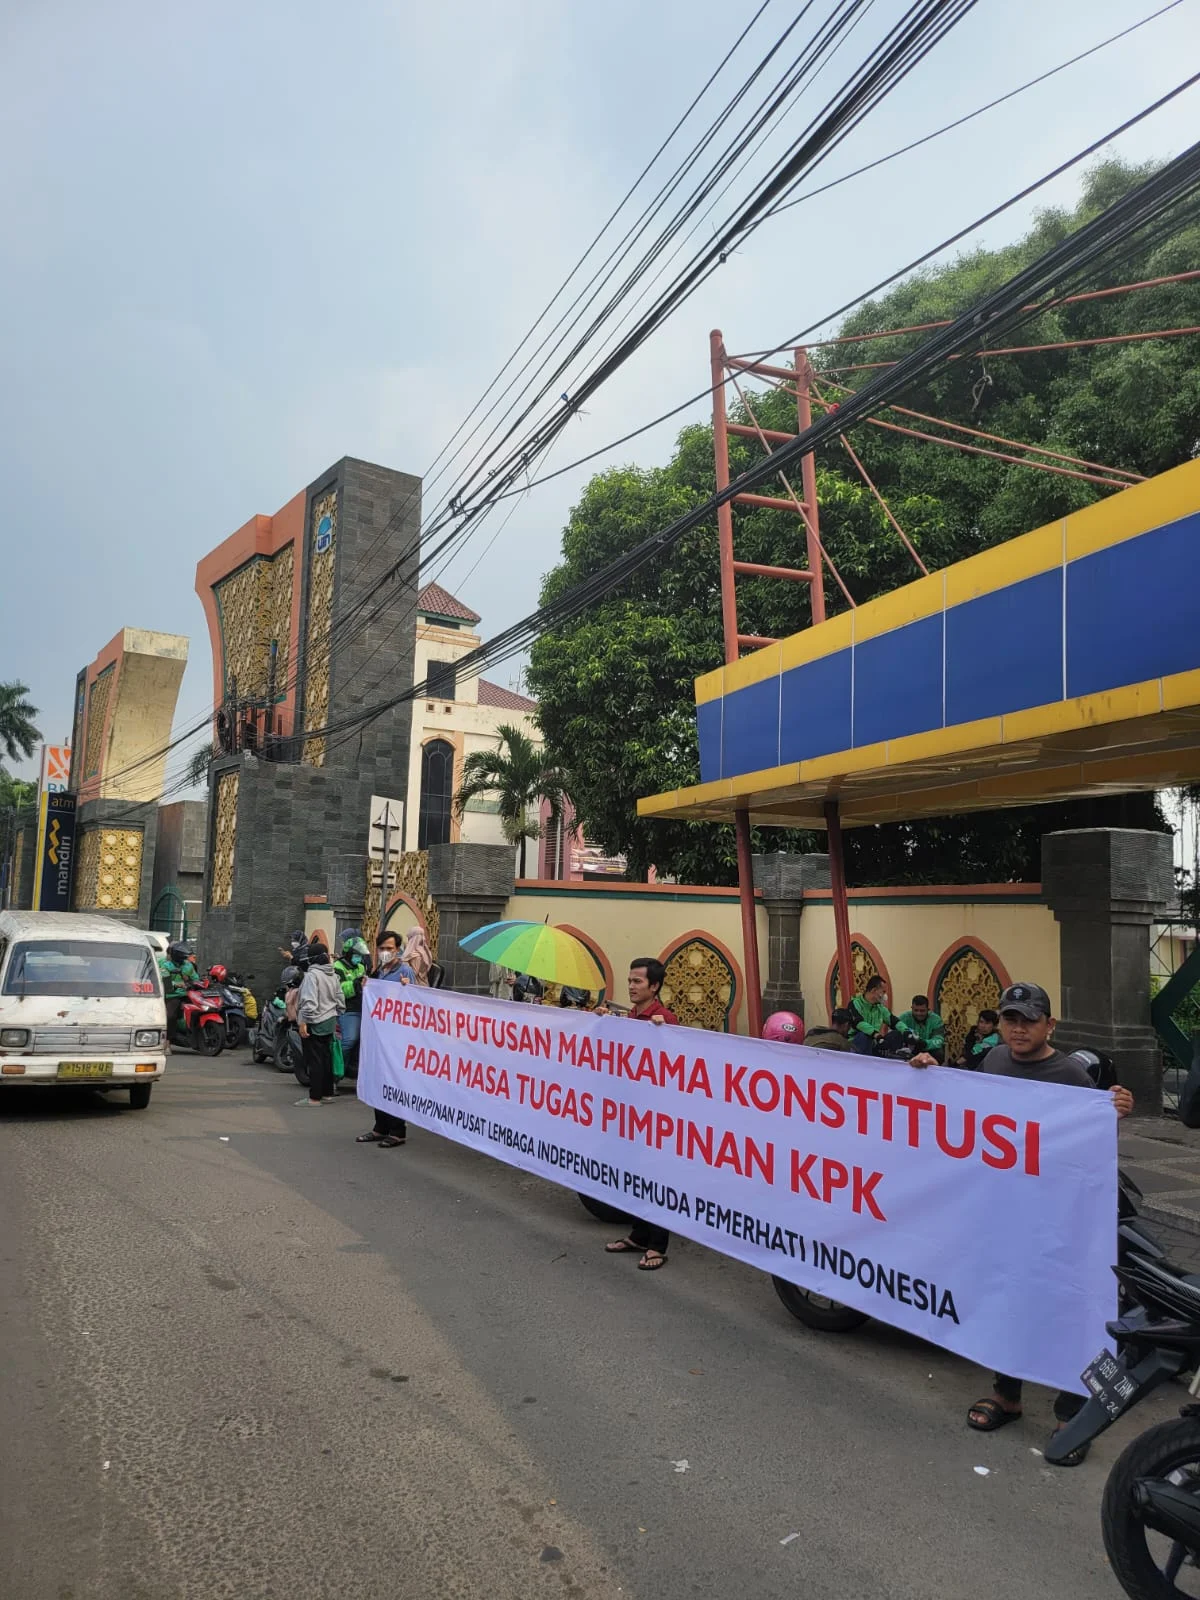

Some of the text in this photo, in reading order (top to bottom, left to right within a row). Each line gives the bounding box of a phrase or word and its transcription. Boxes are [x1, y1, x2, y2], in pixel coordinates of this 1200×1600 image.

[52, 798, 73, 808] atm
[57, 835, 72, 895] mandiri
[370, 996, 1041, 1177] APRESIASI PUTUSAN MAHKAMA KONSTITUSI
[403, 1043, 888, 1223] PADA MASA TUGAS PIMPINAN KPK
[382, 1084, 961, 1326] DEWAN PIMPINAN PUSAT LEMBAGA INDEPENDEN PEMUDA PEMERHATI INDONESIA
[1099, 1358, 1119, 1382] 6691
